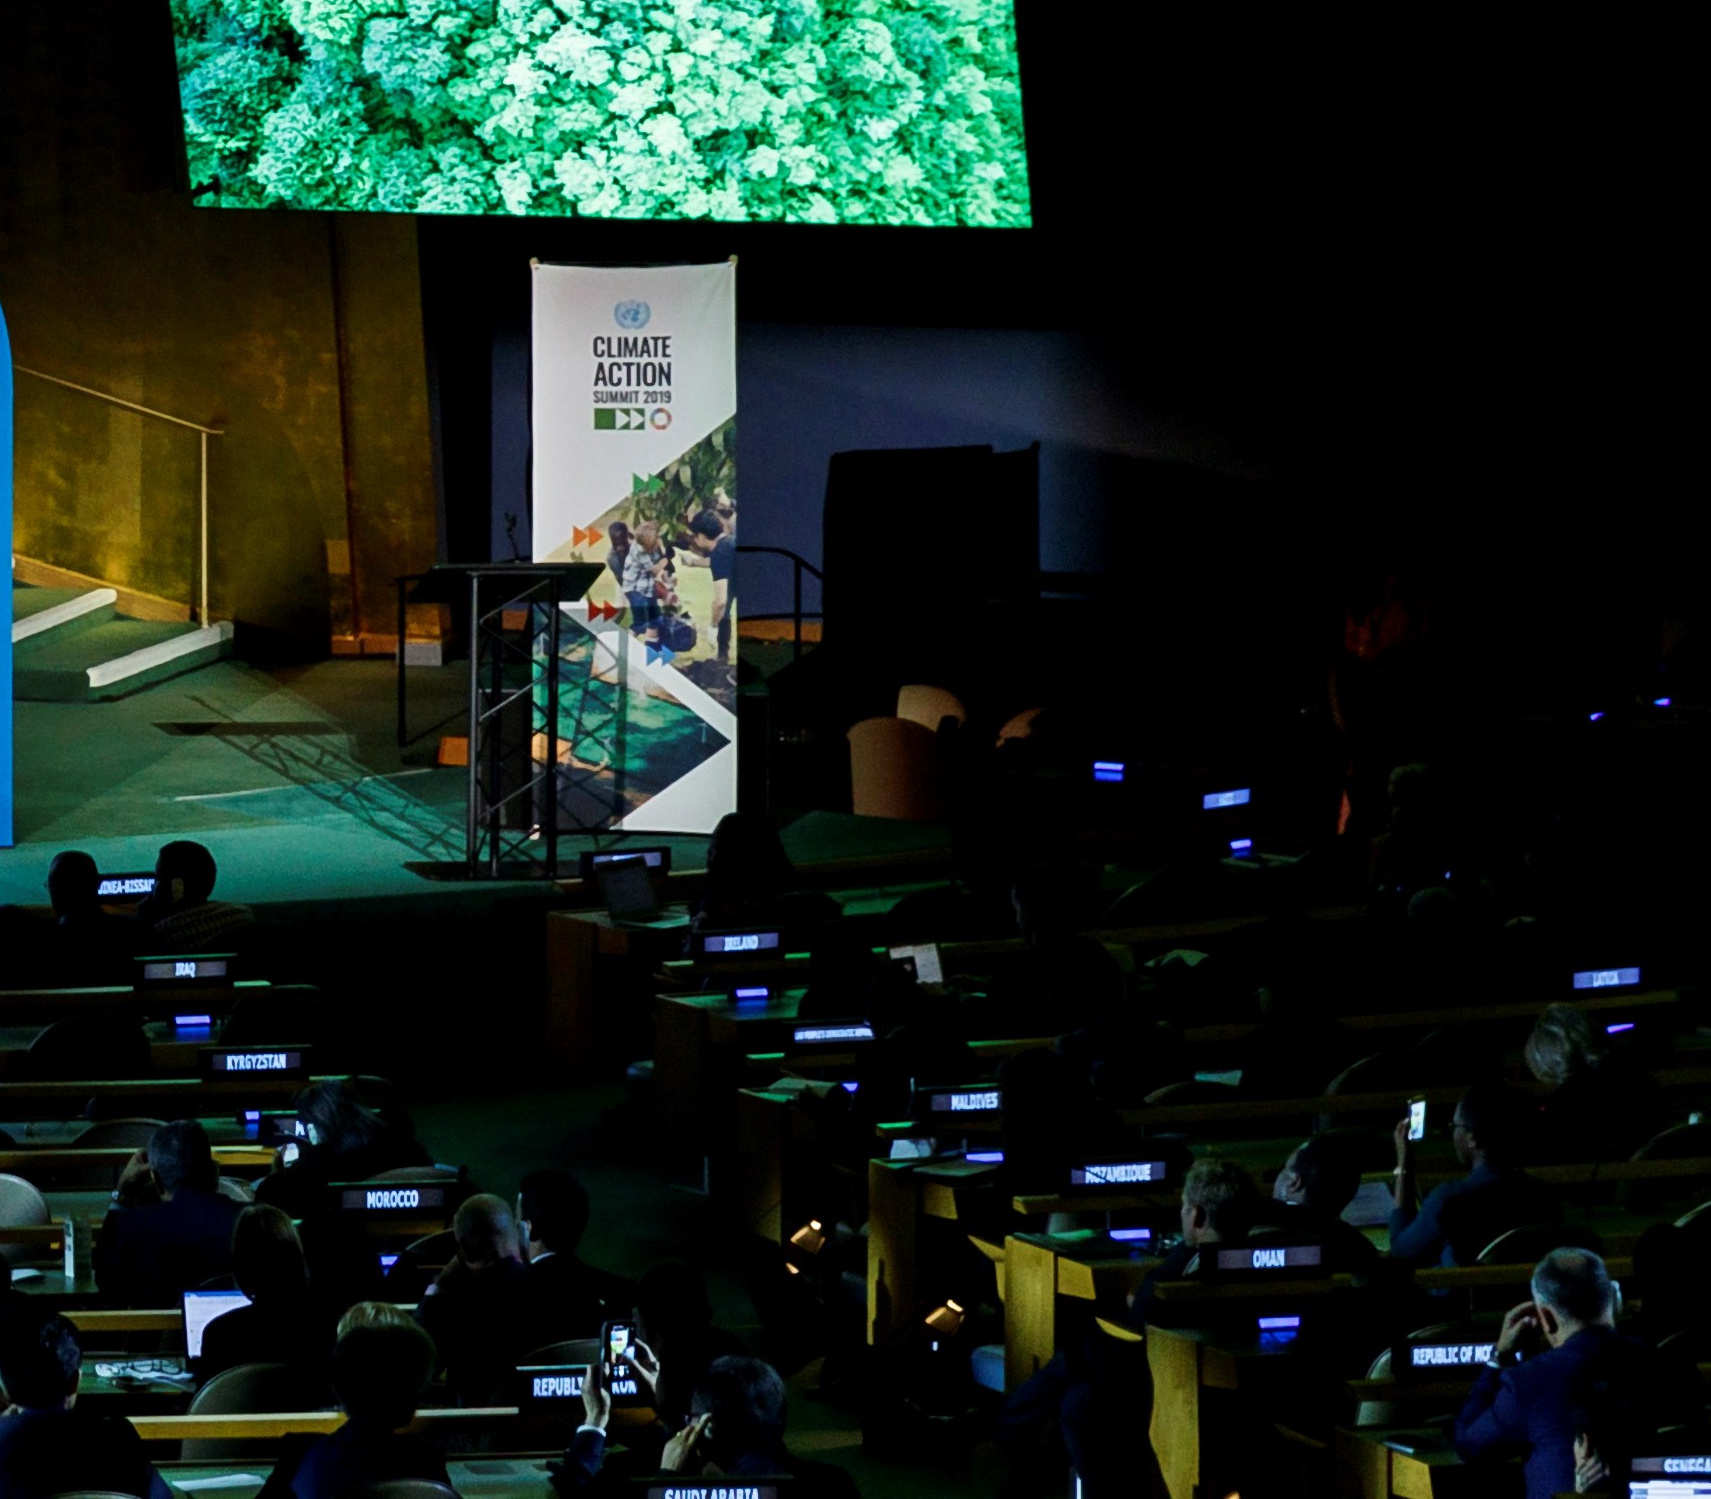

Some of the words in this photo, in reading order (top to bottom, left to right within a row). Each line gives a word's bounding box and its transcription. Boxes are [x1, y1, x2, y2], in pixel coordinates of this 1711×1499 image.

[592, 335, 672, 359] CLIMATE
[593, 361, 672, 387] ACTION
[592, 391, 638, 404] SUMMIT
[642, 390, 672, 404] 2019
[226, 1054, 287, 1071] KYRGYZSTAN
[366, 1190, 420, 1209] MOROCCO
[1252, 1248, 1286, 1269] OMAN
